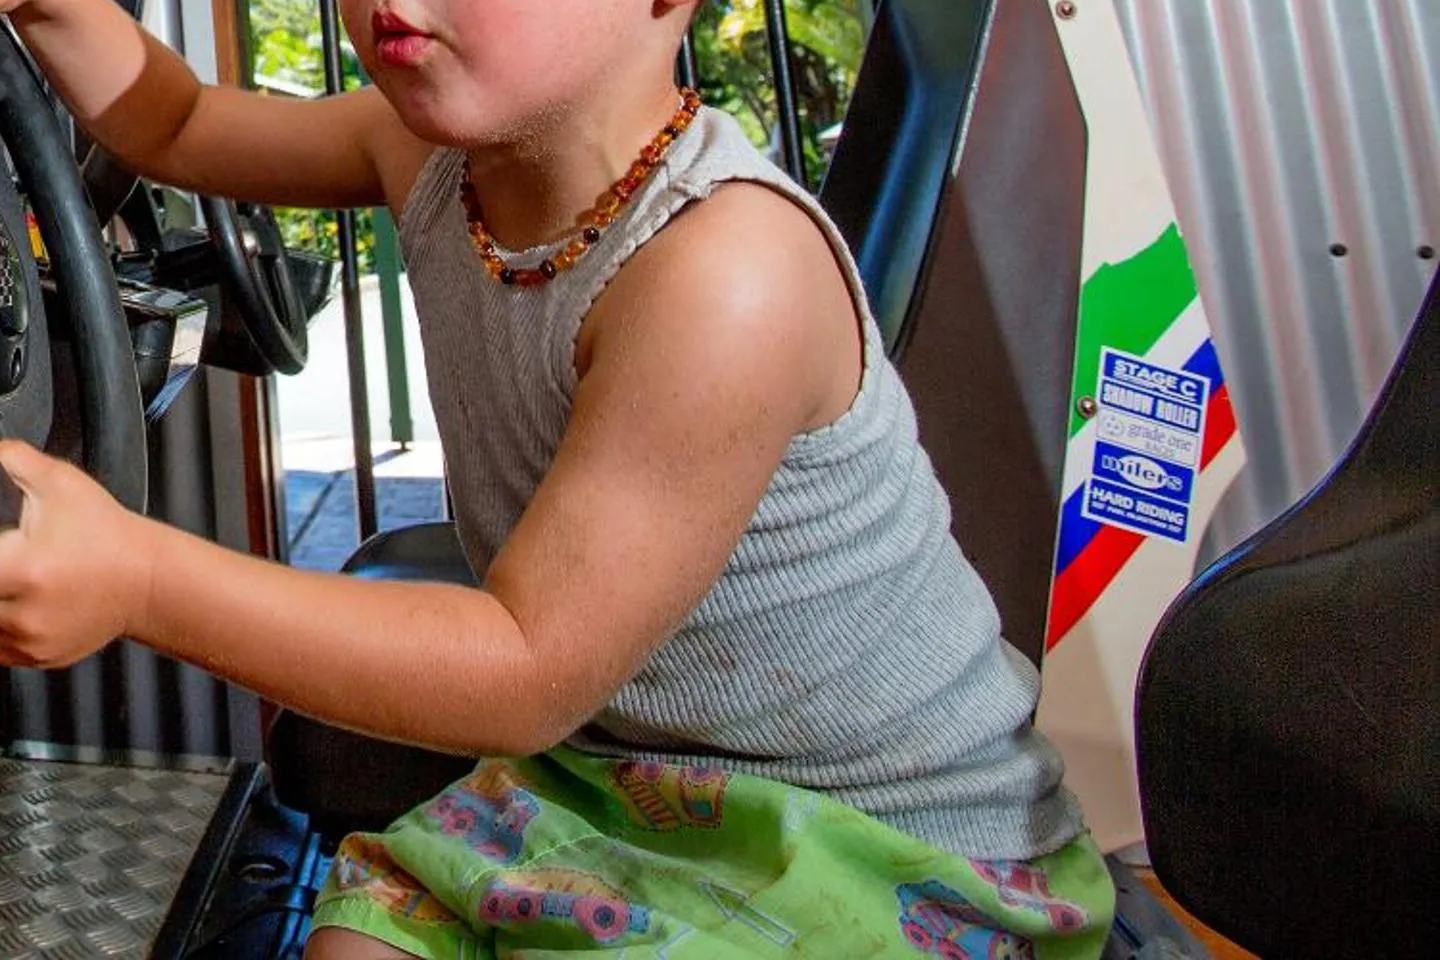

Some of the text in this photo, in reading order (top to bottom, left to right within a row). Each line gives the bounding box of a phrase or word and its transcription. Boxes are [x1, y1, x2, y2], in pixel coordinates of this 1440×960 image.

[1113, 359, 1197, 398] STAGE C
[1092, 487, 1134, 510] HARD
